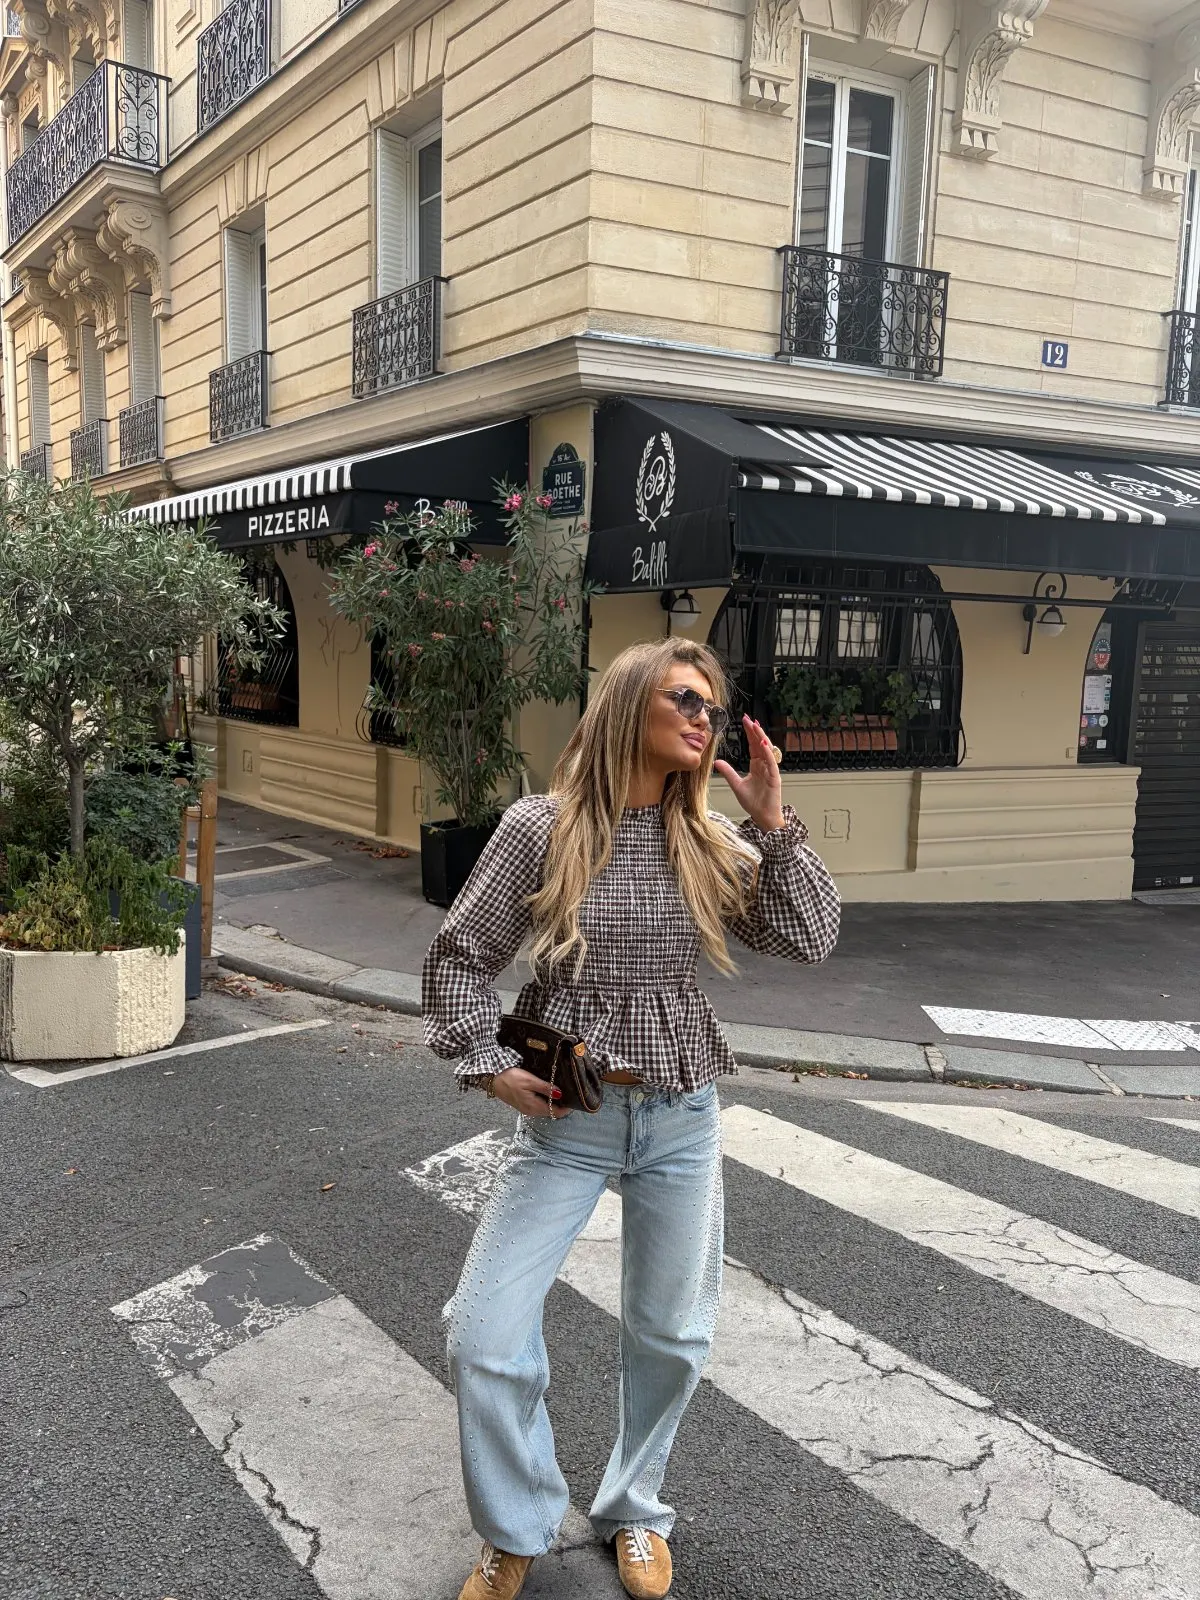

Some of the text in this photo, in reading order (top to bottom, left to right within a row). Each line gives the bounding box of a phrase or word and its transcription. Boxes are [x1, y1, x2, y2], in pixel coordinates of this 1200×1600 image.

[1046, 343, 1064, 365] 12
[555, 472, 572, 486] RUE
[547, 485, 580, 500] GOETHE
[248, 504, 330, 538] PIZZERIA
